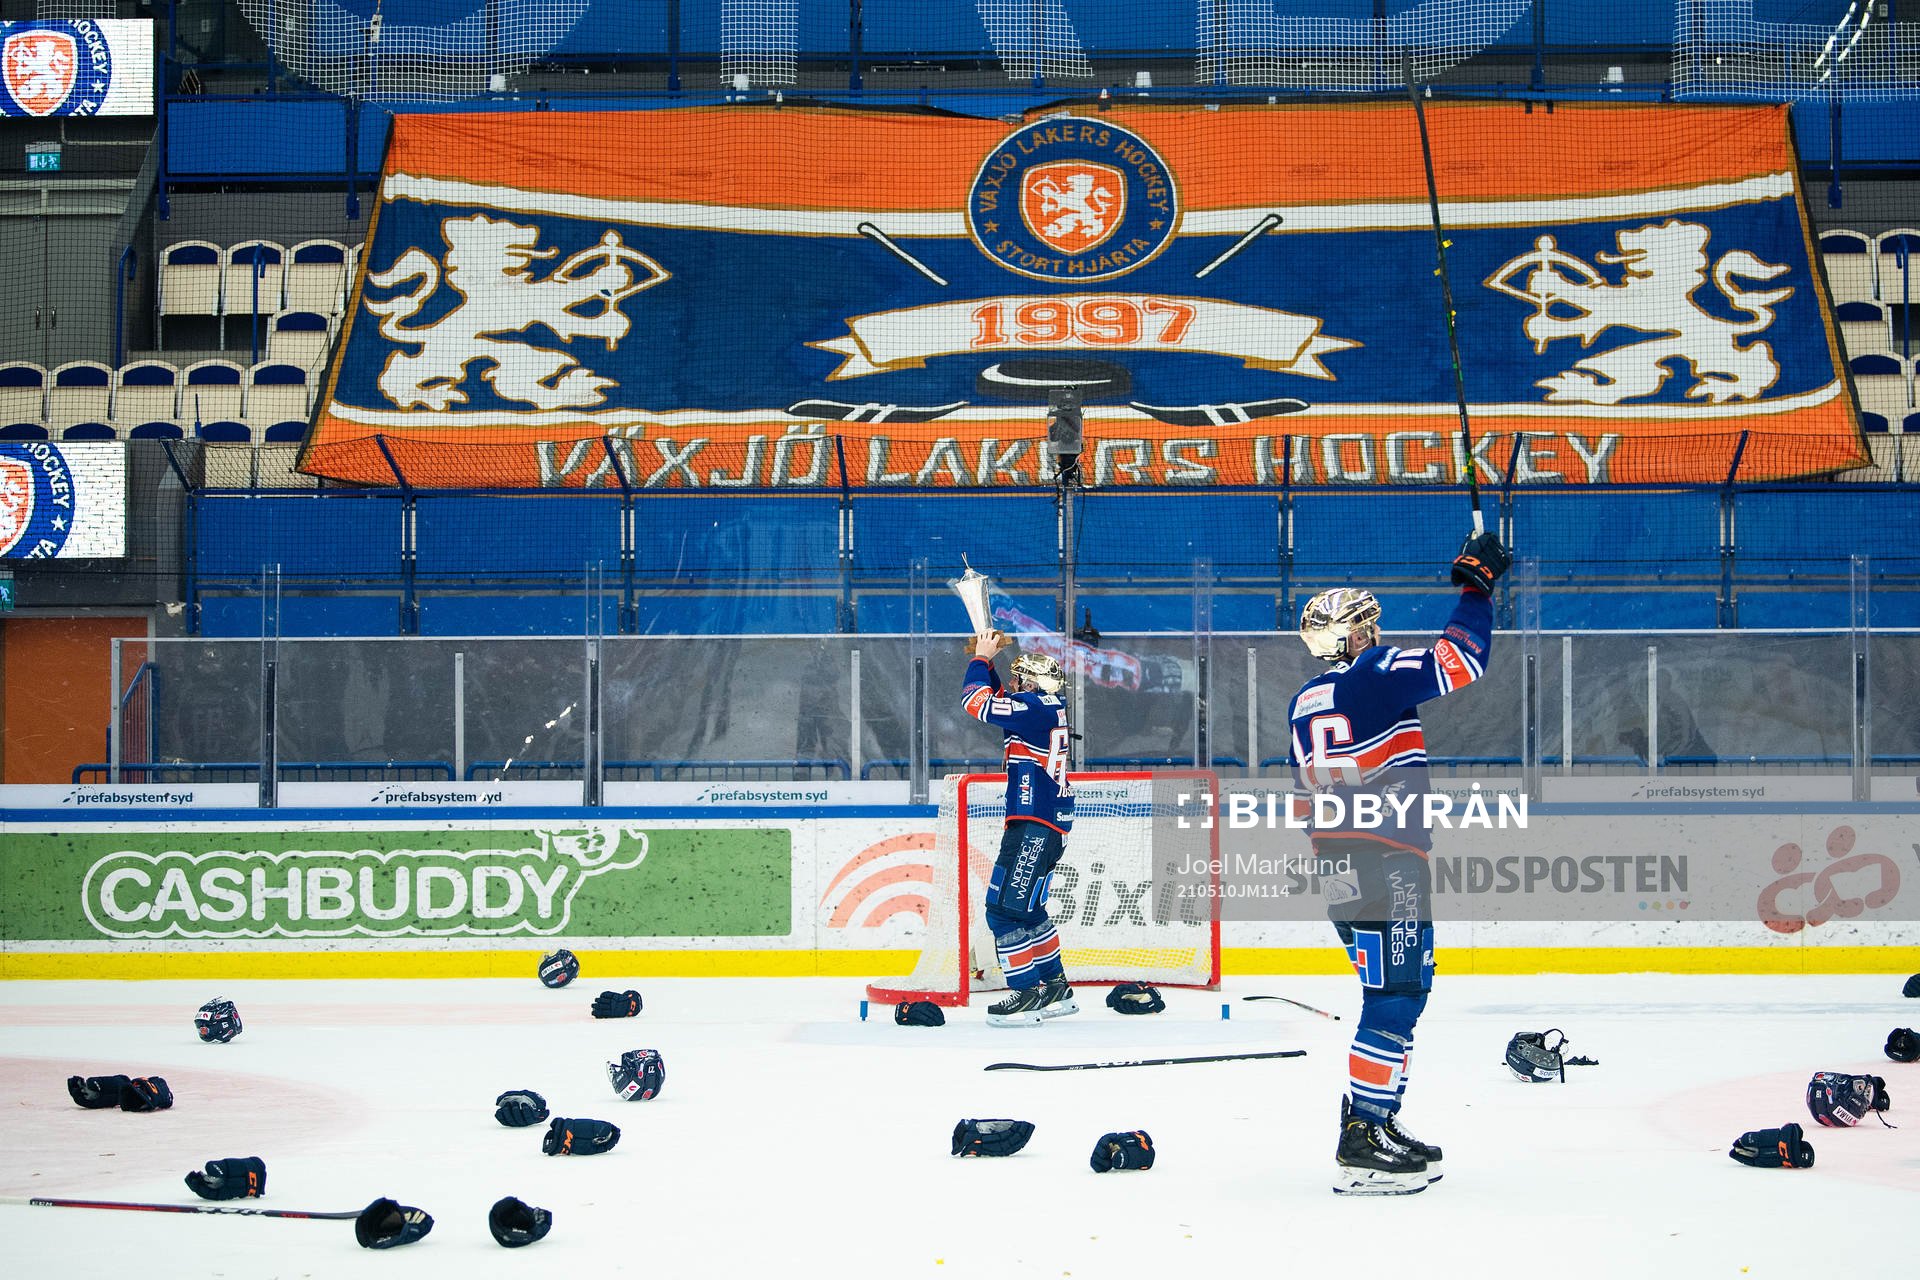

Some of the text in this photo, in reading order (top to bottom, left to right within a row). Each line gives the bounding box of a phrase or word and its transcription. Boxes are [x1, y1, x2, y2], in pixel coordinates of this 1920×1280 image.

[1016, 125, 1111, 155] LAKERS
[1113, 140, 1169, 215] HOCKEY
[996, 239, 1064, 273] STORT
[970, 298, 1197, 349] 1997
[535, 423, 833, 489] VÄXJÖ
[1254, 431, 1623, 485] HOCKEY
[170, 792, 193, 805] syd
[385, 791, 477, 805] prefabsystem
[711, 790, 828, 804] prefabsystem syd
[1646, 787, 1765, 799] prefabsystem syd
[1011, 845, 1032, 888] NORDIC
[100, 865, 569, 923] CASHBUDDY
[1405, 883, 1418, 947] NORDIC
